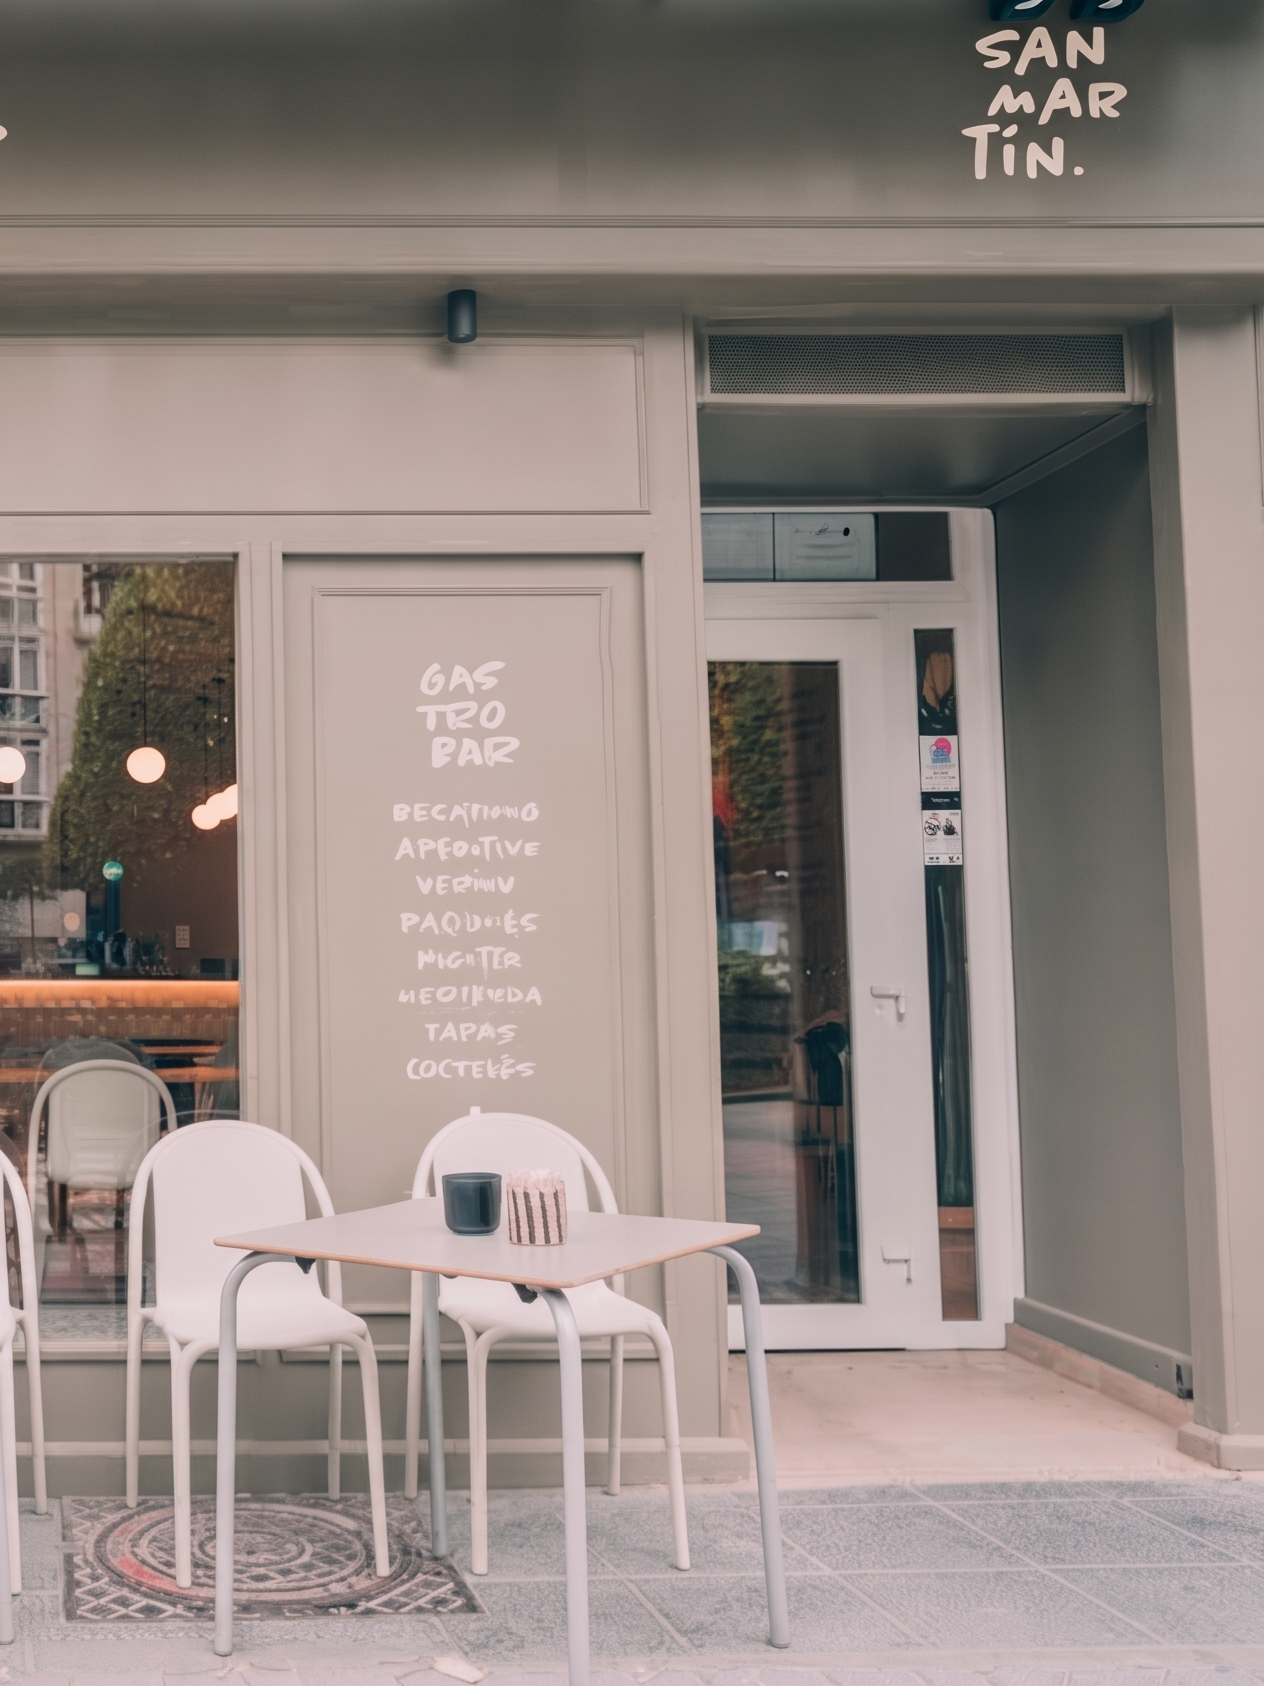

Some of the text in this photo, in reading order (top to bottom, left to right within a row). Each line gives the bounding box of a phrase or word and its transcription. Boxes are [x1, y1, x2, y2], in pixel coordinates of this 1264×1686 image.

[975, 26, 1105, 76] SAN
[987, 77, 1128, 125] MAR
[419, 660, 506, 696] GAS
[415, 699, 506, 732] TRO
[431, 736, 521, 768] BAR
[424, 1021, 518, 1046] TAPAS
